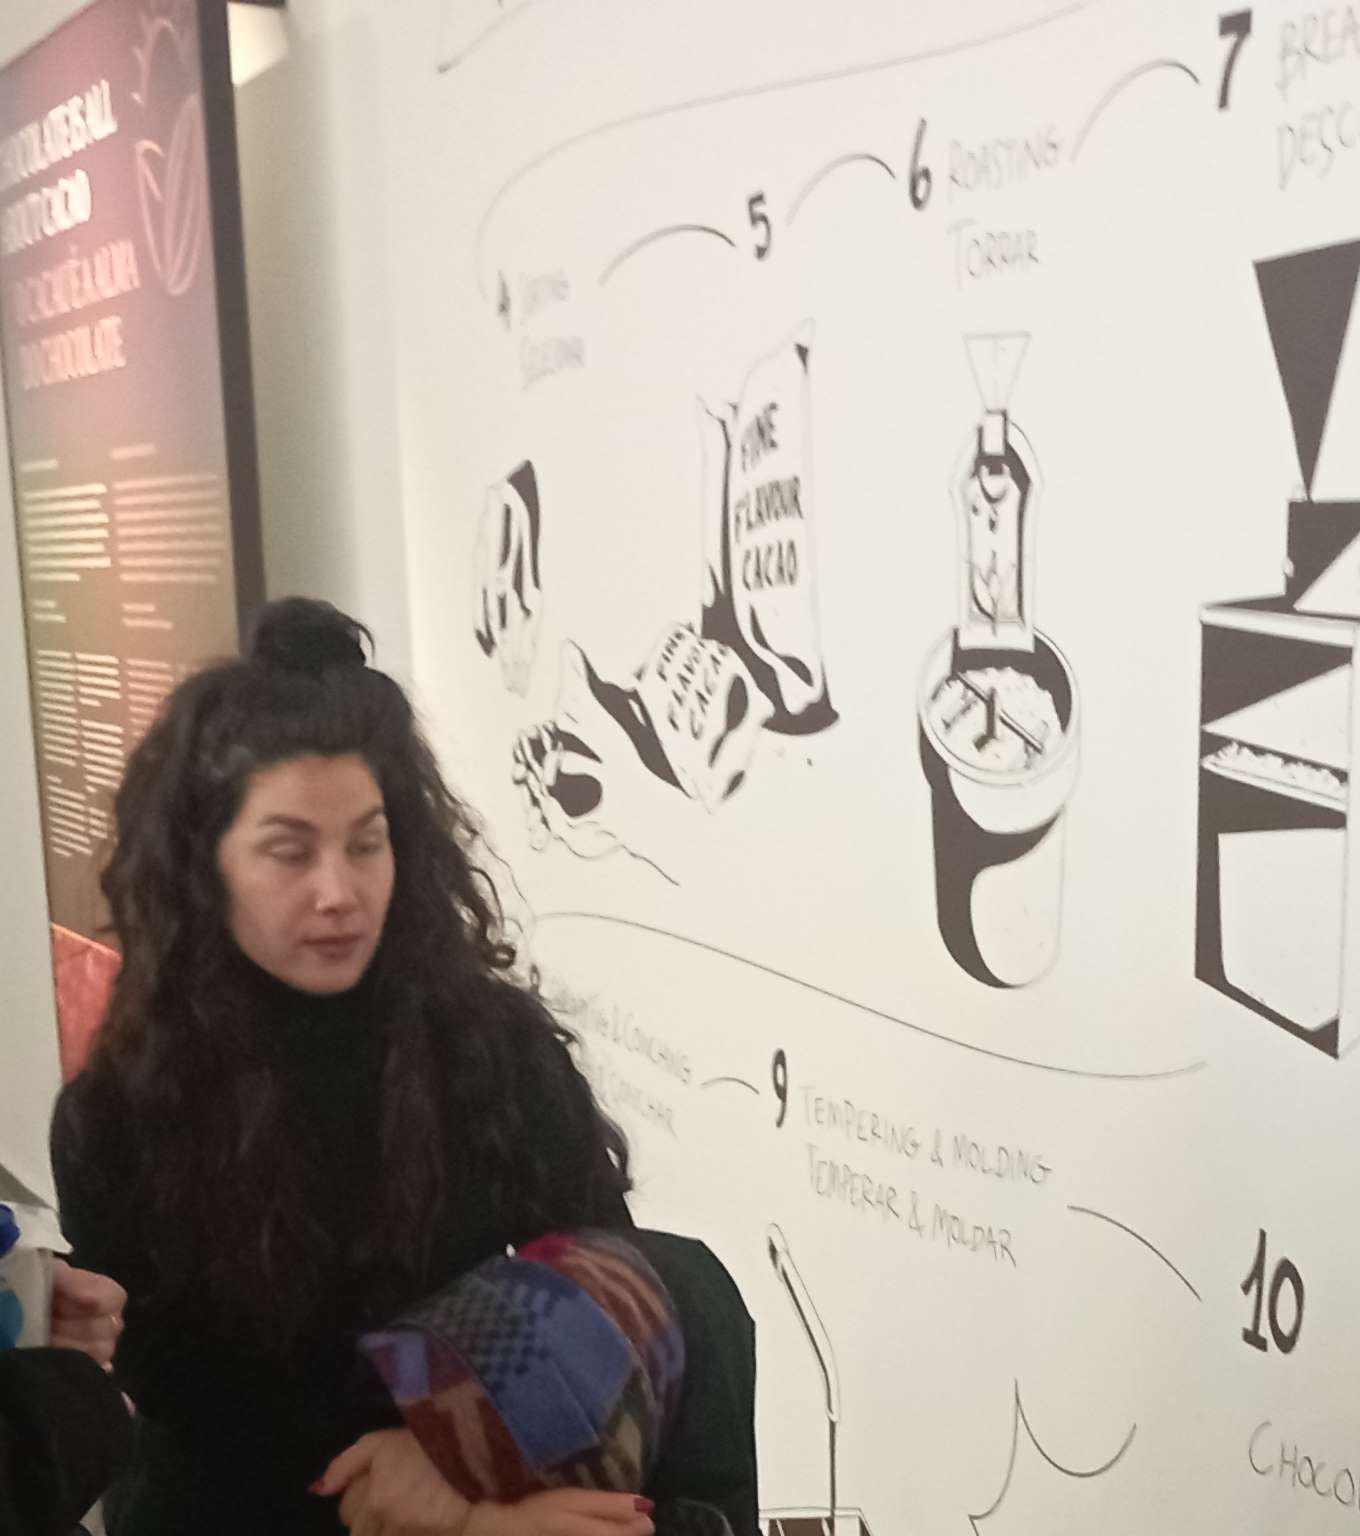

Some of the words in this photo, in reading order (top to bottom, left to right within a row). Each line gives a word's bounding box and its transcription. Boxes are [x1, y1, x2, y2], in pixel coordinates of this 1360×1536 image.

[1217, 10, 1253, 110] 7
[909, 117, 932, 212] 6
[747, 191, 772, 262] 5
[943, 217, 1040, 290] TORRAR
[741, 402, 779, 473] FINE
[735, 475, 804, 546] FLAVOUR
[742, 539, 798, 592] CACAO
[772, 1048, 788, 1129] 9
[797, 1085, 921, 1160] TEMPERING
[930, 1128, 944, 1168] &
[952, 1133, 1053, 1184] MOLDING
[805, 1142, 901, 1222] TEMPERAR
[908, 1190, 924, 1238] &
[932, 1202, 1017, 1268] MOLDAR
[1240, 1228, 1305, 1355] 10
